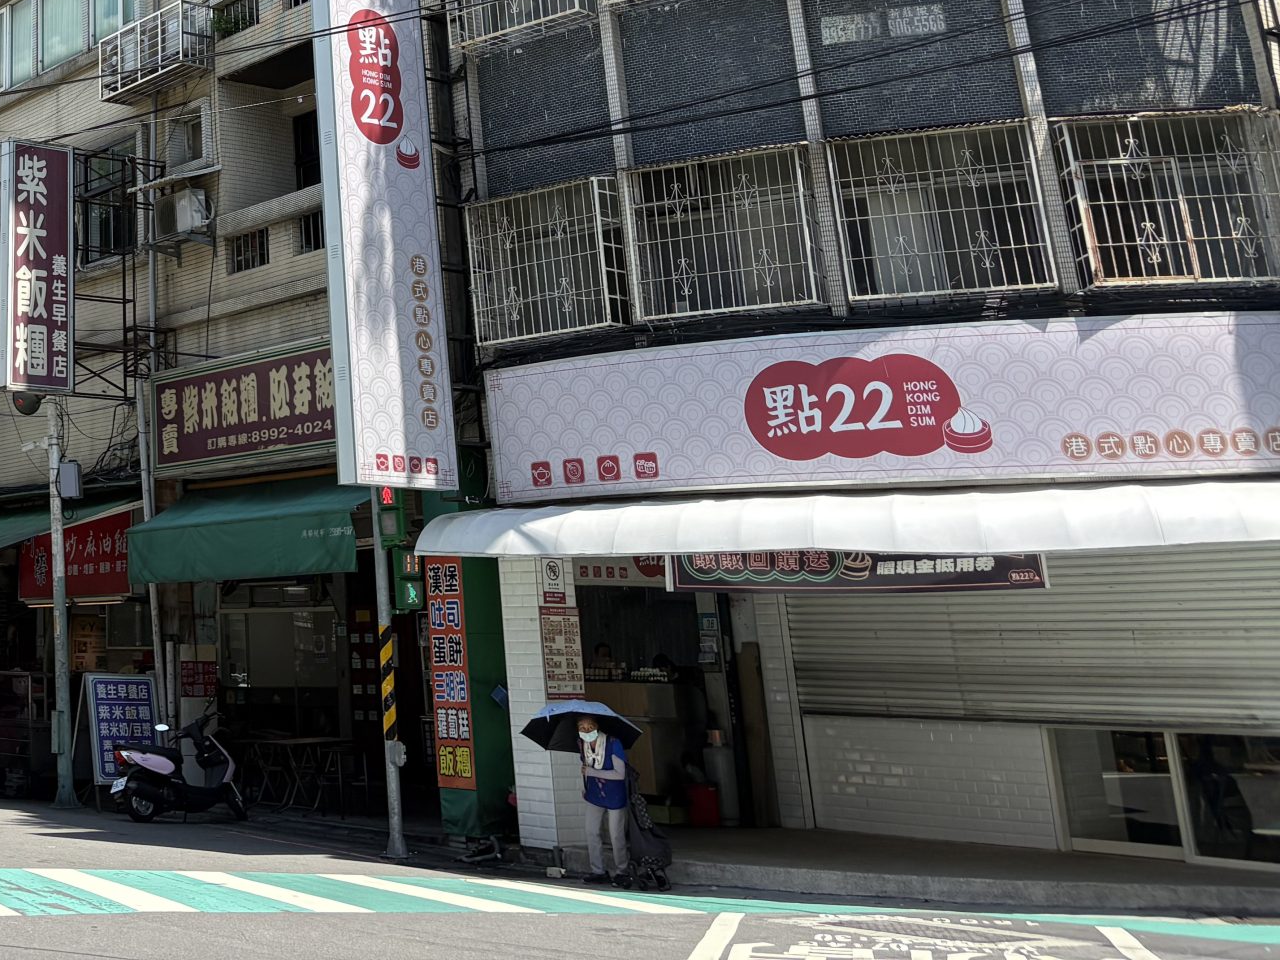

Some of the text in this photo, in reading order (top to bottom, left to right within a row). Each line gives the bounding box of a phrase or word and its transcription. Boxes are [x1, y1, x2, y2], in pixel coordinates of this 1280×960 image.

[357, 24, 392, 67] 點
[361, 68, 379, 79] HONG
[362, 76, 392, 89] KONG SUM
[359, 88, 398, 129] 22
[15, 154, 47, 376] 紫米飯糰
[51, 253, 67, 378] 養生早餐店
[412, 257, 437, 428] 港式點心專賣店
[903, 380, 937, 392] HONG
[906, 392, 940, 403] KONG
[160, 388, 179, 455] 專賣
[762, 380, 903, 438] 點22
[907, 404, 931, 415] DIM
[910, 416, 936, 427] SUM
[427, 563, 459, 595] 漢堡
[430, 599, 460, 630] 吐司
[432, 635, 463, 666] 蛋餅
[96, 683, 148, 699] 養生早餐店
[434, 671, 467, 702] 三明治
[98, 705, 151, 720] 紫米飯糰
[437, 706, 470, 740] 蘿蔔糕
[438, 745, 472, 778] 飯糰
